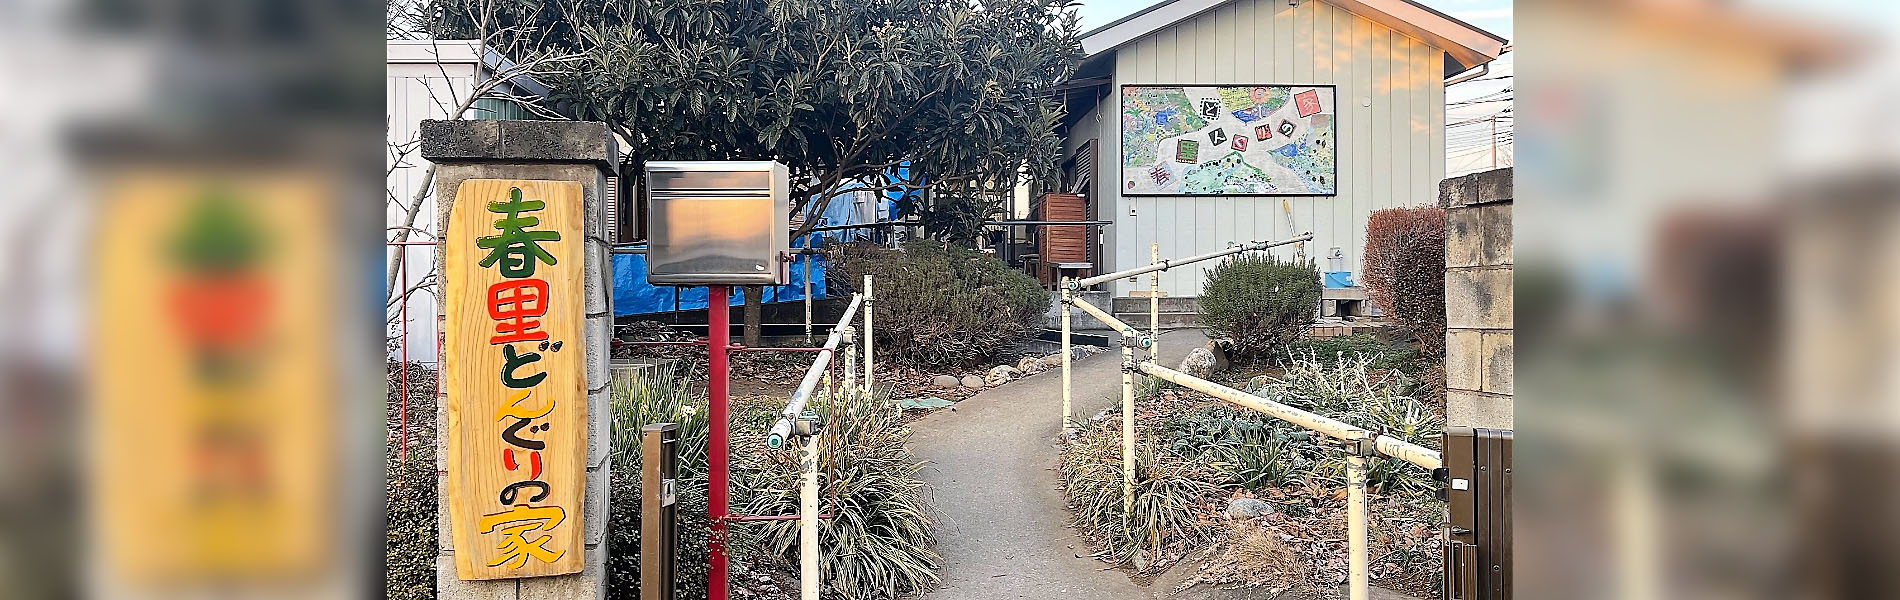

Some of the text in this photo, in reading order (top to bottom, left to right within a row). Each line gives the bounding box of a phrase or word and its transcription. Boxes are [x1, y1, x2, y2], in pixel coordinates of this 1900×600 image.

[476, 187, 567, 569] 春里どんぐりの家
